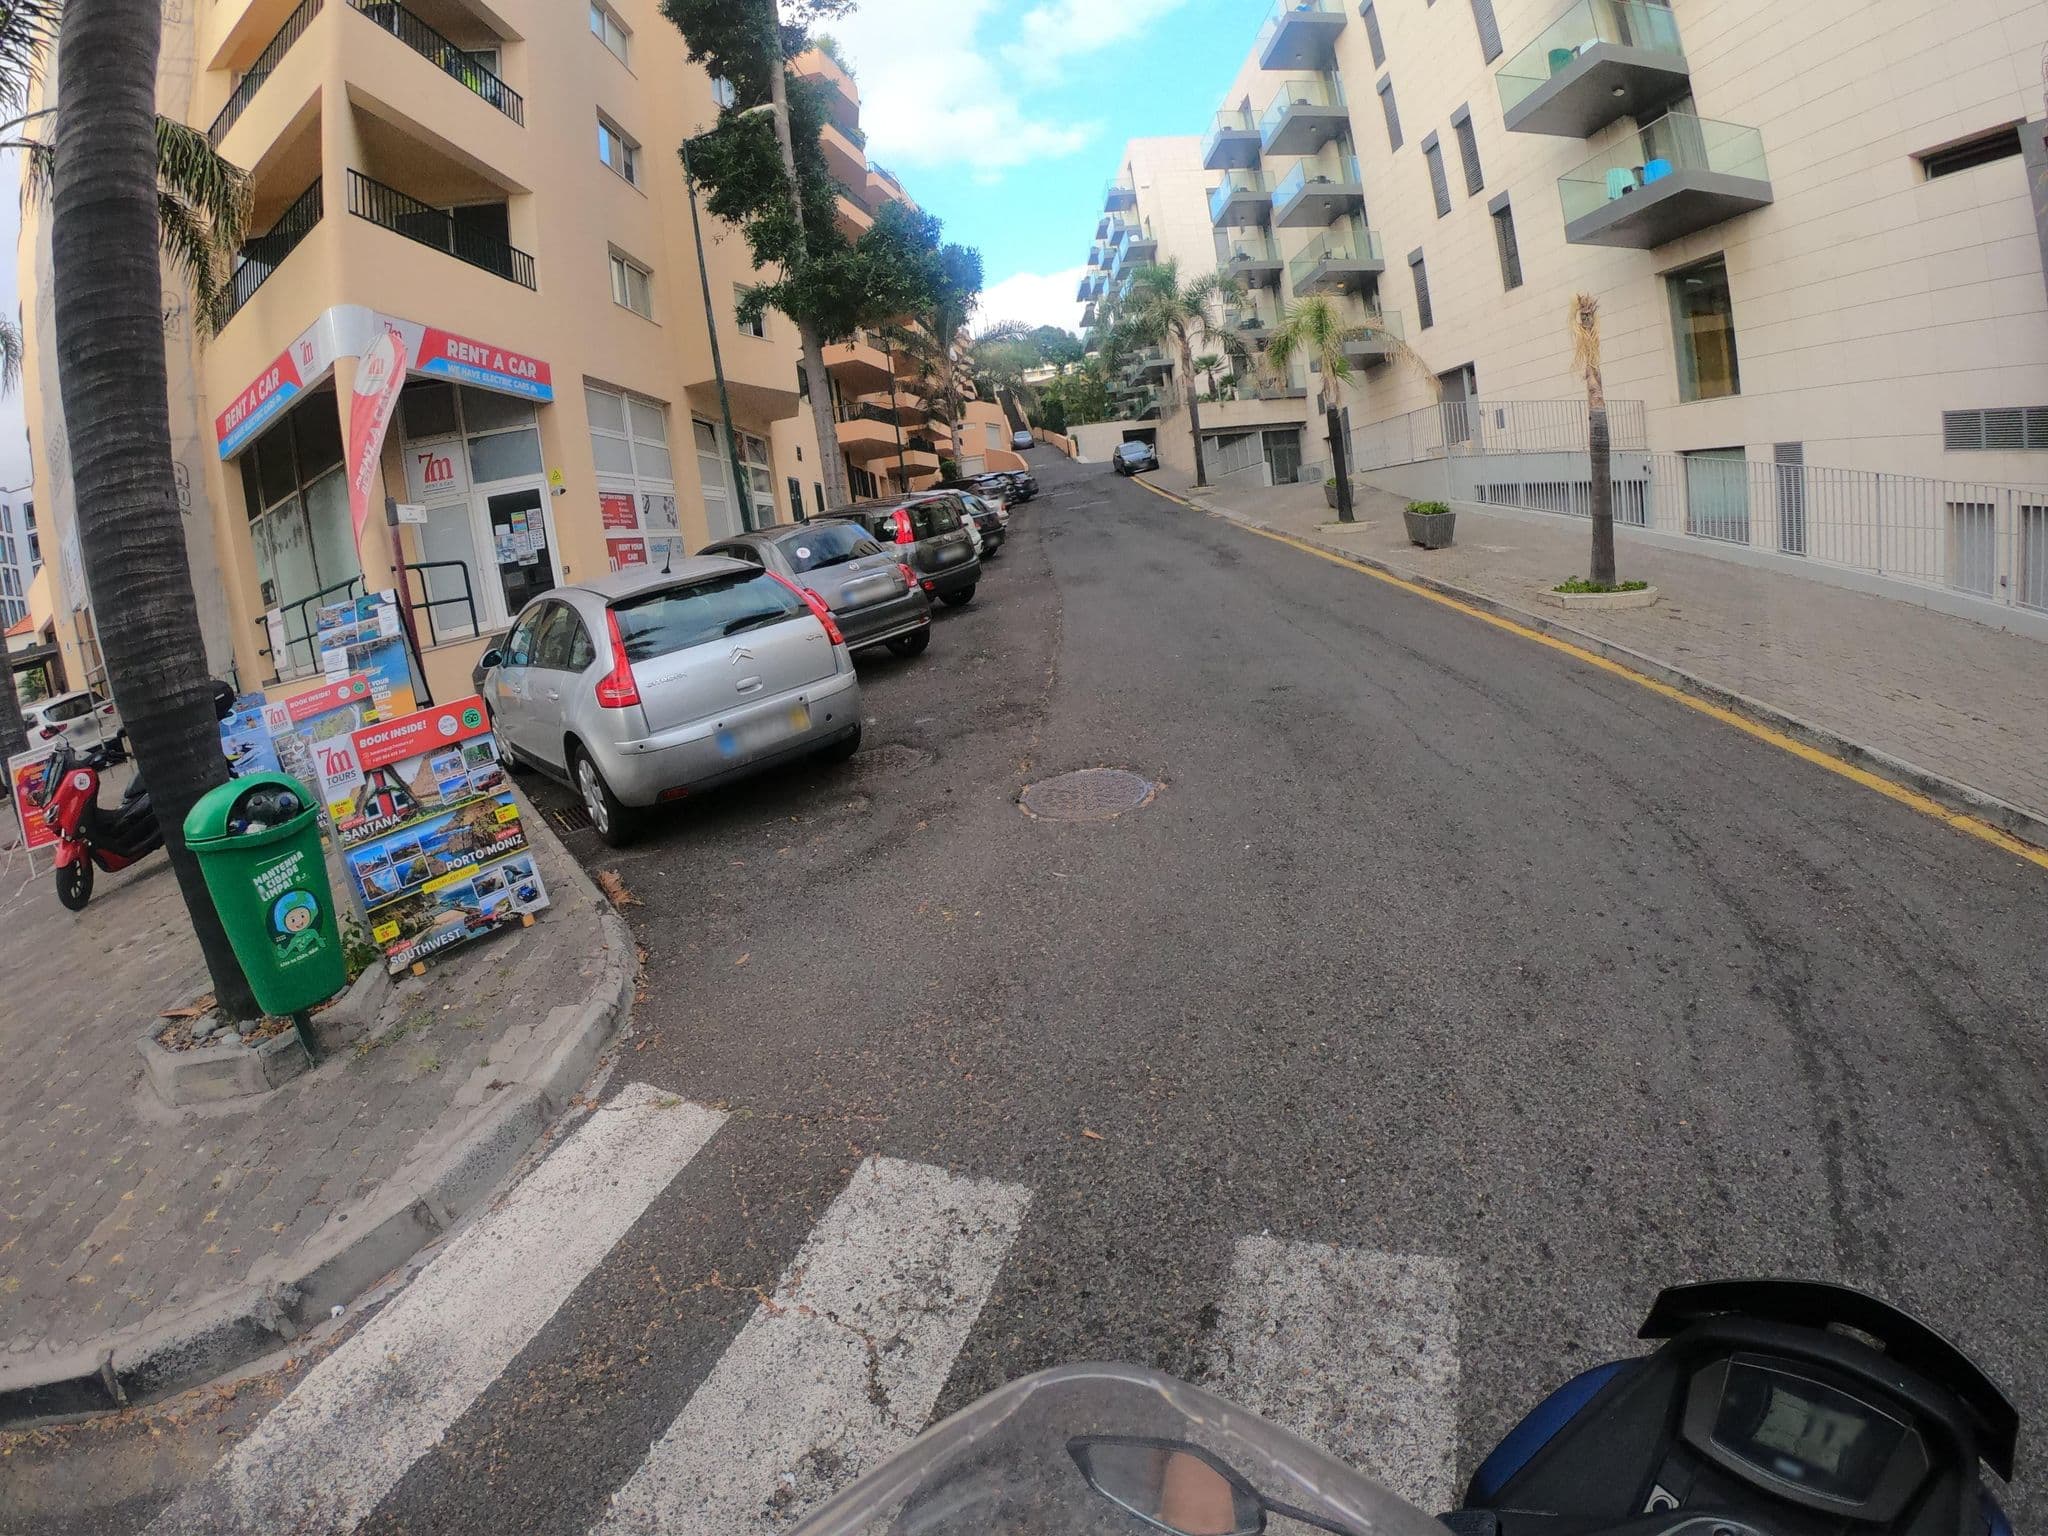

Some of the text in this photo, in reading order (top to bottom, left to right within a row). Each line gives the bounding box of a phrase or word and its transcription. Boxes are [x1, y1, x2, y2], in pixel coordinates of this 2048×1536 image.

[301, 340, 314, 366] 7m
[447, 338, 537, 379] RENT A CAR
[462, 367, 481, 381] HAVE
[225, 394, 248, 432] RENT
[250, 391, 257, 411] A
[258, 367, 280, 397] CAR
[418, 452, 454, 483] 7m
[265, 708, 286, 724] 7m
[290, 697, 308, 709] BOOK
[359, 732, 389, 748] BOOK
[390, 719, 427, 740] INSIDE!
[317, 747, 354, 777] 7m
[327, 770, 356, 786] TOURS
[343, 813, 400, 841] SANTANA
[446, 834, 523, 871] PORTO MONIZ
[253, 851, 304, 886] MANTENHA
[266, 864, 299, 889] CIDADE
[260, 878, 293, 902] LIMPA!
[390, 928, 461, 965] SOUTHWEST
